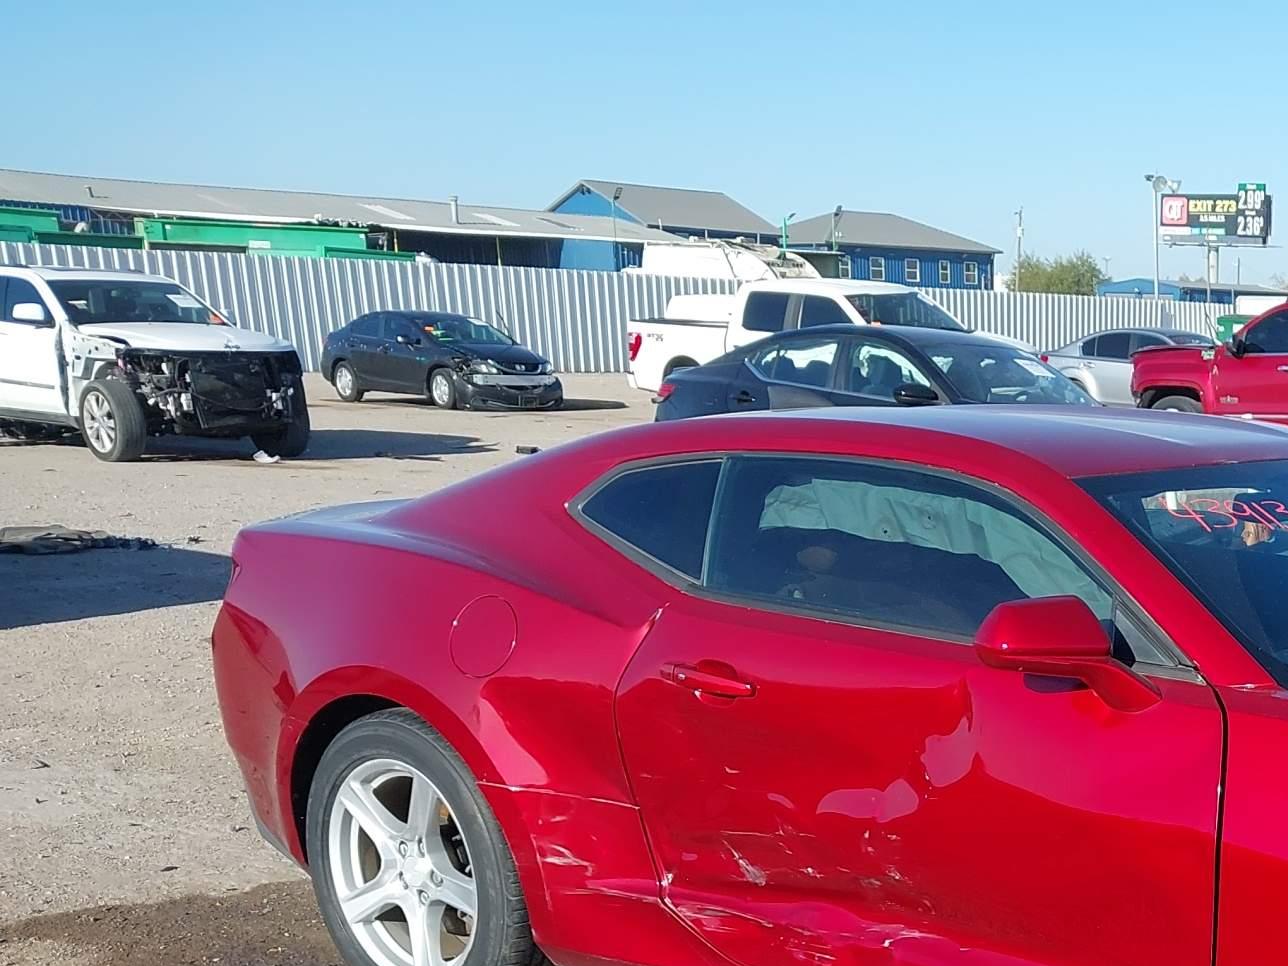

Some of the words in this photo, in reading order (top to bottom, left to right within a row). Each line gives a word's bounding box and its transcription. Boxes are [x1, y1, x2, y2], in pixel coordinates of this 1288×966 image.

[1166, 201, 1185, 221] QT
[1189, 199, 1215, 212] EXIT
[1215, 199, 1237, 213] 273
